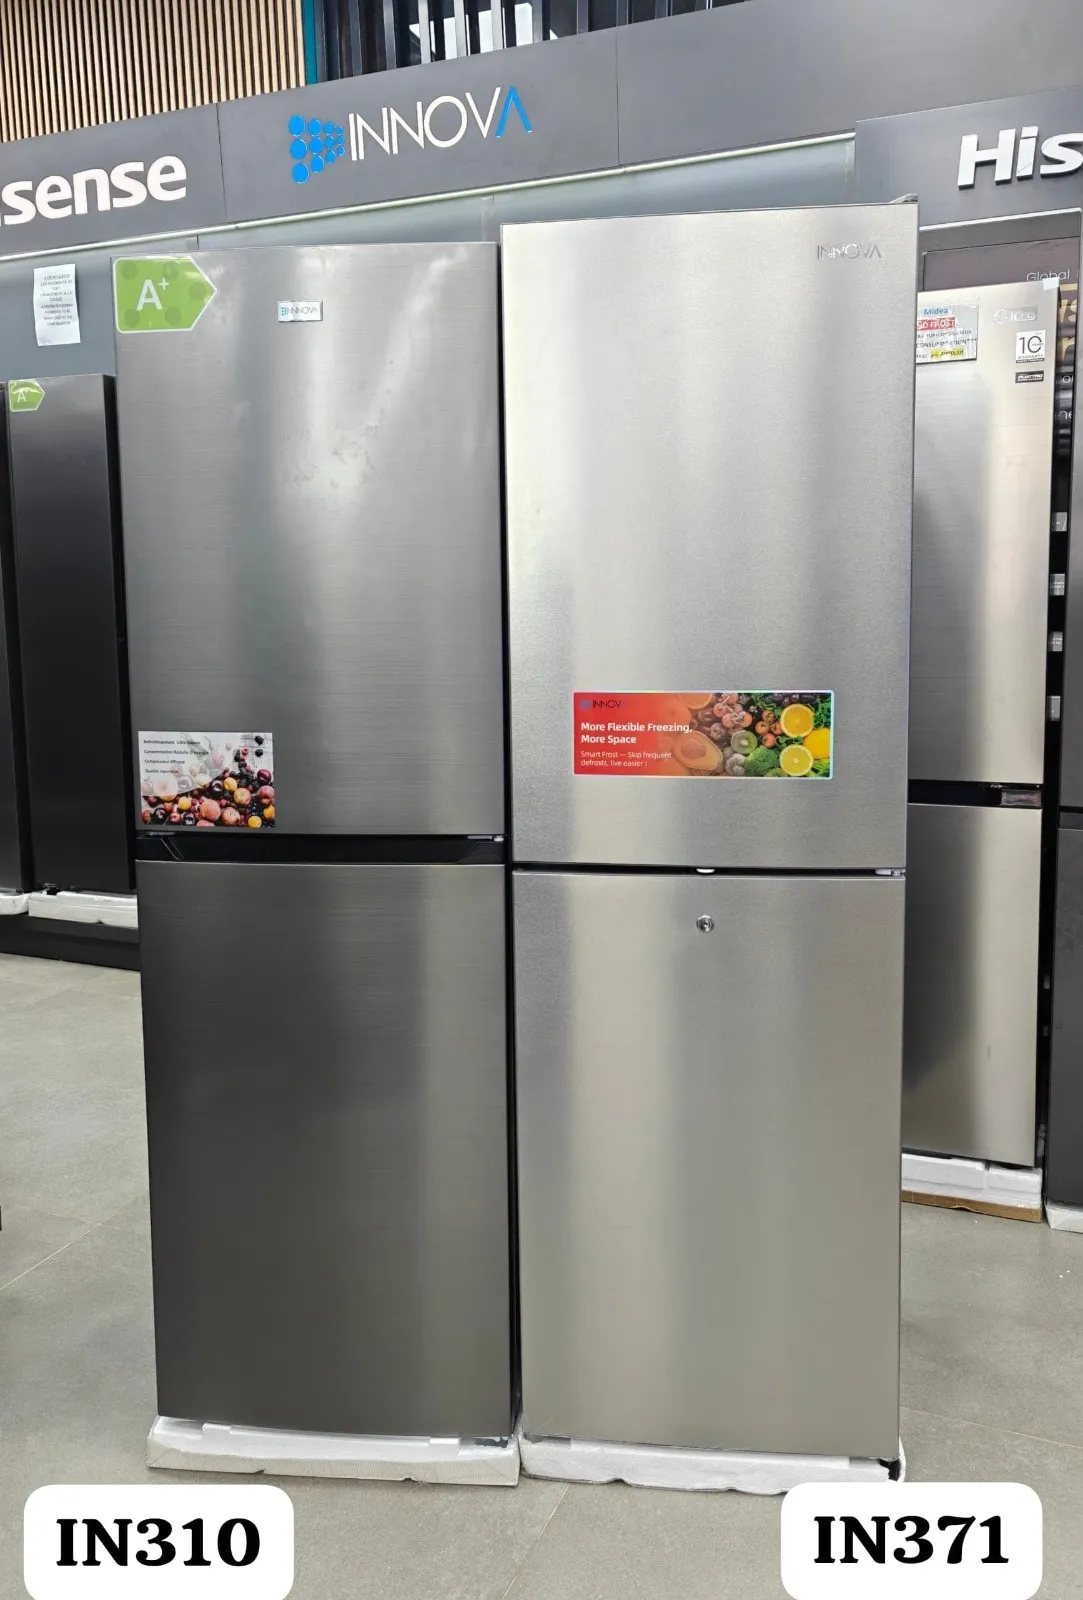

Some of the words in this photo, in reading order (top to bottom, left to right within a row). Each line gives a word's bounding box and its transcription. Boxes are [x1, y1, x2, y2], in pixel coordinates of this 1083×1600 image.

[348, 84, 533, 161] INNOVA
[957, 125, 1083, 187] His
[0, 155, 187, 227] sense
[817, 243, 882, 259] INNOVA
[581, 722, 605, 731] More
[607, 722, 646, 732] Flexible
[647, 723, 693, 734] Freezing,
[581, 735, 606, 743] More
[607, 735, 637, 745] Space
[581, 759, 609, 767] defrosts,
[628, 751, 642, 760] Skip
[643, 752, 672, 761] frequent
